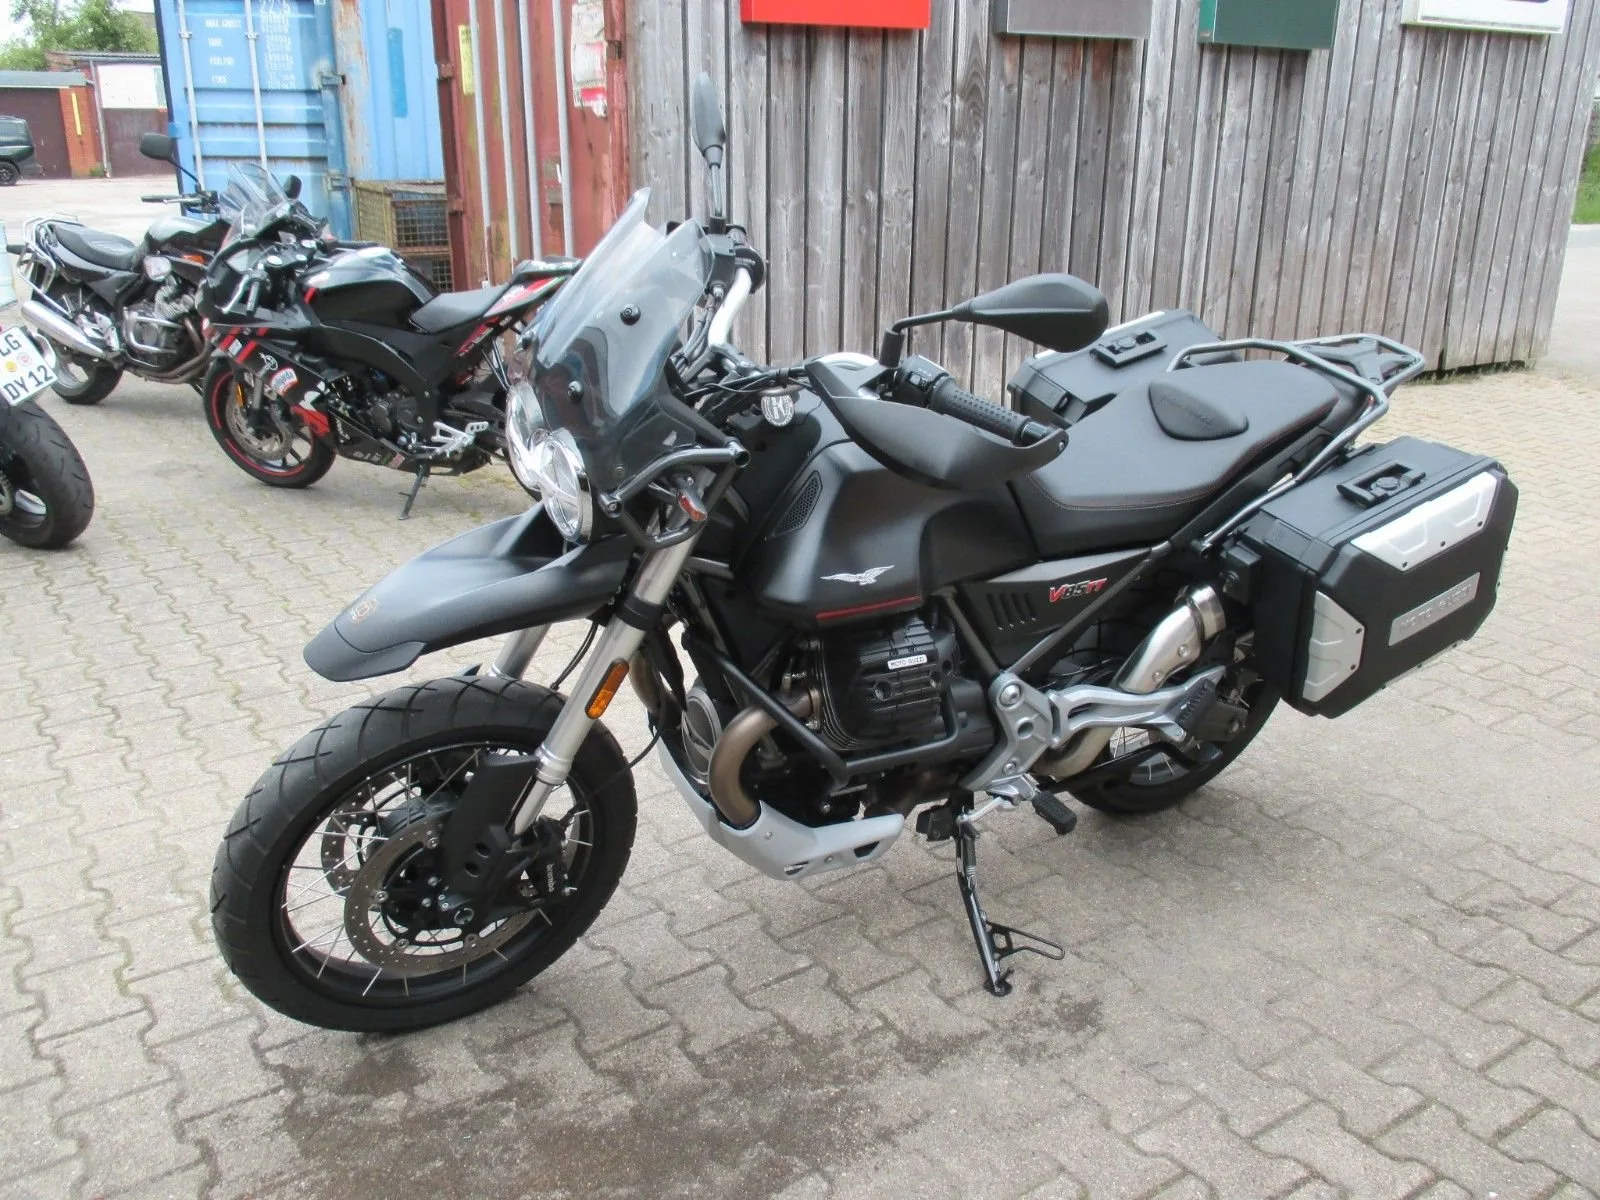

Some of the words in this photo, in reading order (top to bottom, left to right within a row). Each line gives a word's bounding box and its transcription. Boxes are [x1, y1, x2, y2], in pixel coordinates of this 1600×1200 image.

[3, 376, 30, 401] DY
[28, 364, 54, 388] 12
[890, 659, 907, 668] MOTO
[908, 656, 925, 665] GUZZI
[546, 863, 556, 893] brembo
